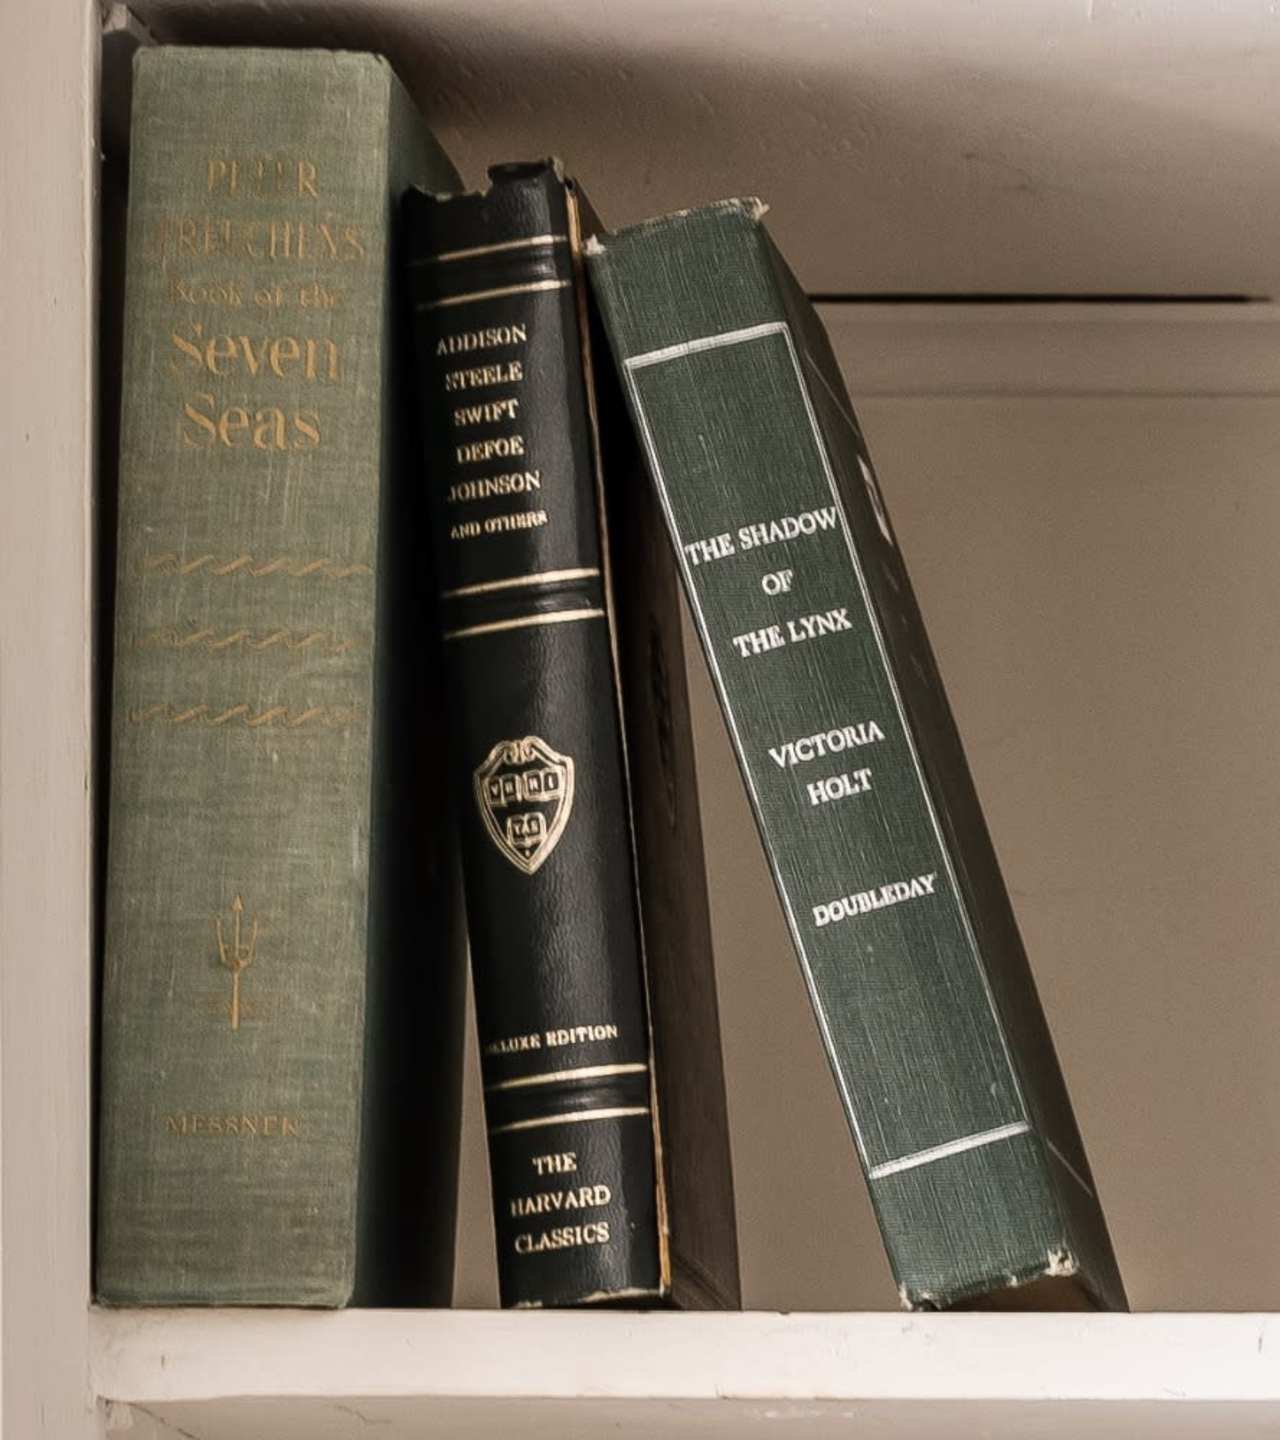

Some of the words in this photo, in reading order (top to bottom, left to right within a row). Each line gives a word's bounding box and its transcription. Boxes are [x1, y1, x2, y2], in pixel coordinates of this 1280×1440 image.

[166, 321, 342, 381] Seven
[436, 322, 528, 357] ADDISON
[445, 360, 523, 392] STEELE
[182, 391, 322, 450] Seas
[453, 398, 520, 428] SWIFT
[455, 435, 525, 465] DEFOE
[447, 469, 542, 503] JOHNSON
[450, 521, 483, 540] AND
[484, 509, 548, 536] OTHERS
[684, 533, 736, 566] THE
[738, 506, 837, 551] SHADOW
[761, 568, 794, 596] OF
[732, 624, 786, 658] THE
[786, 608, 853, 643] LYNX
[768, 720, 886, 769] VICTORIA
[806, 767, 873, 806] HOLT
[812, 870, 938, 927] DOUBLEDAY
[545, 1024, 619, 1048] EDITION
[531, 1151, 578, 1176] THE
[511, 1184, 612, 1217] HARVARD
[514, 1221, 611, 1254] CLASSICS
